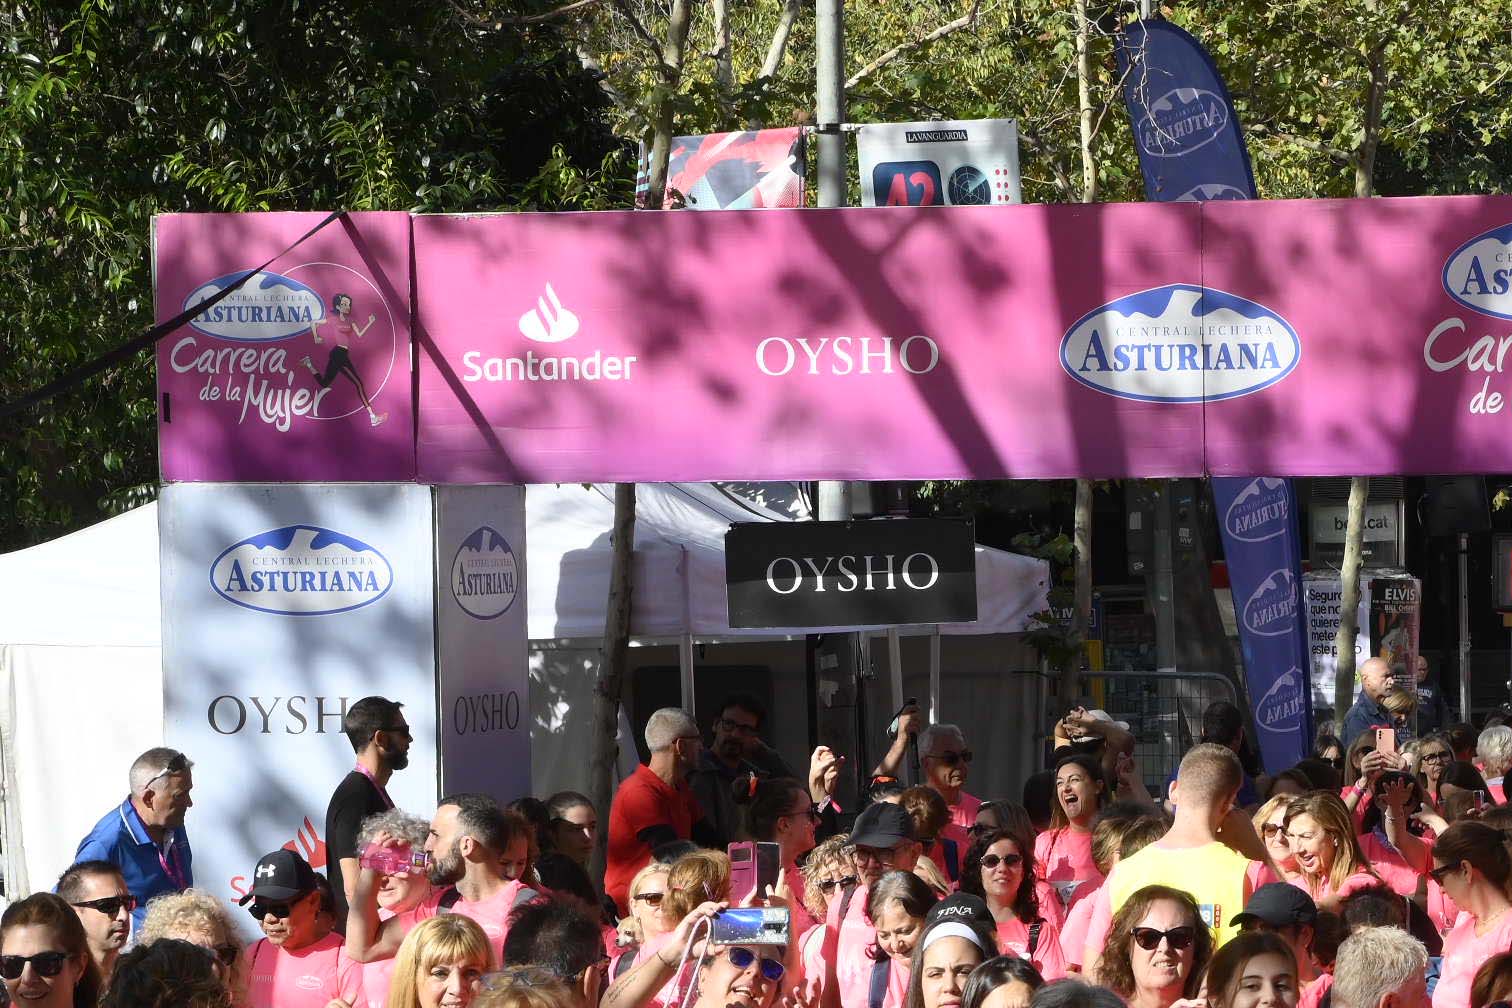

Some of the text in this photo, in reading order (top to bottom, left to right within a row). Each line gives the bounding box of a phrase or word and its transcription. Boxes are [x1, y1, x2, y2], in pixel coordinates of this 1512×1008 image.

[194, 296, 313, 323] ASTURIANA
[1116, 324, 1274, 337] CENTRAL LECHERA
[170, 336, 287, 374] Carrera
[462, 350, 637, 382] Santander
[755, 335, 939, 376] OYSHO
[1079, 340, 1282, 373] ASTURIANA
[199, 372, 332, 432] de la Mujer
[1469, 376, 1502, 414] de
[225, 558, 380, 593] ASTURIANA
[252, 556, 375, 566] CENTRAL LECHERA
[766, 552, 939, 594] OYSHO
[456, 561, 516, 599] ASTURIANA
[1385, 588, 1416, 601] ELVIS
[1310, 604, 1328, 617] que
[1311, 645, 1330, 655] este
[207, 694, 348, 736] OYSH
[454, 690, 521, 735] OYSHO
